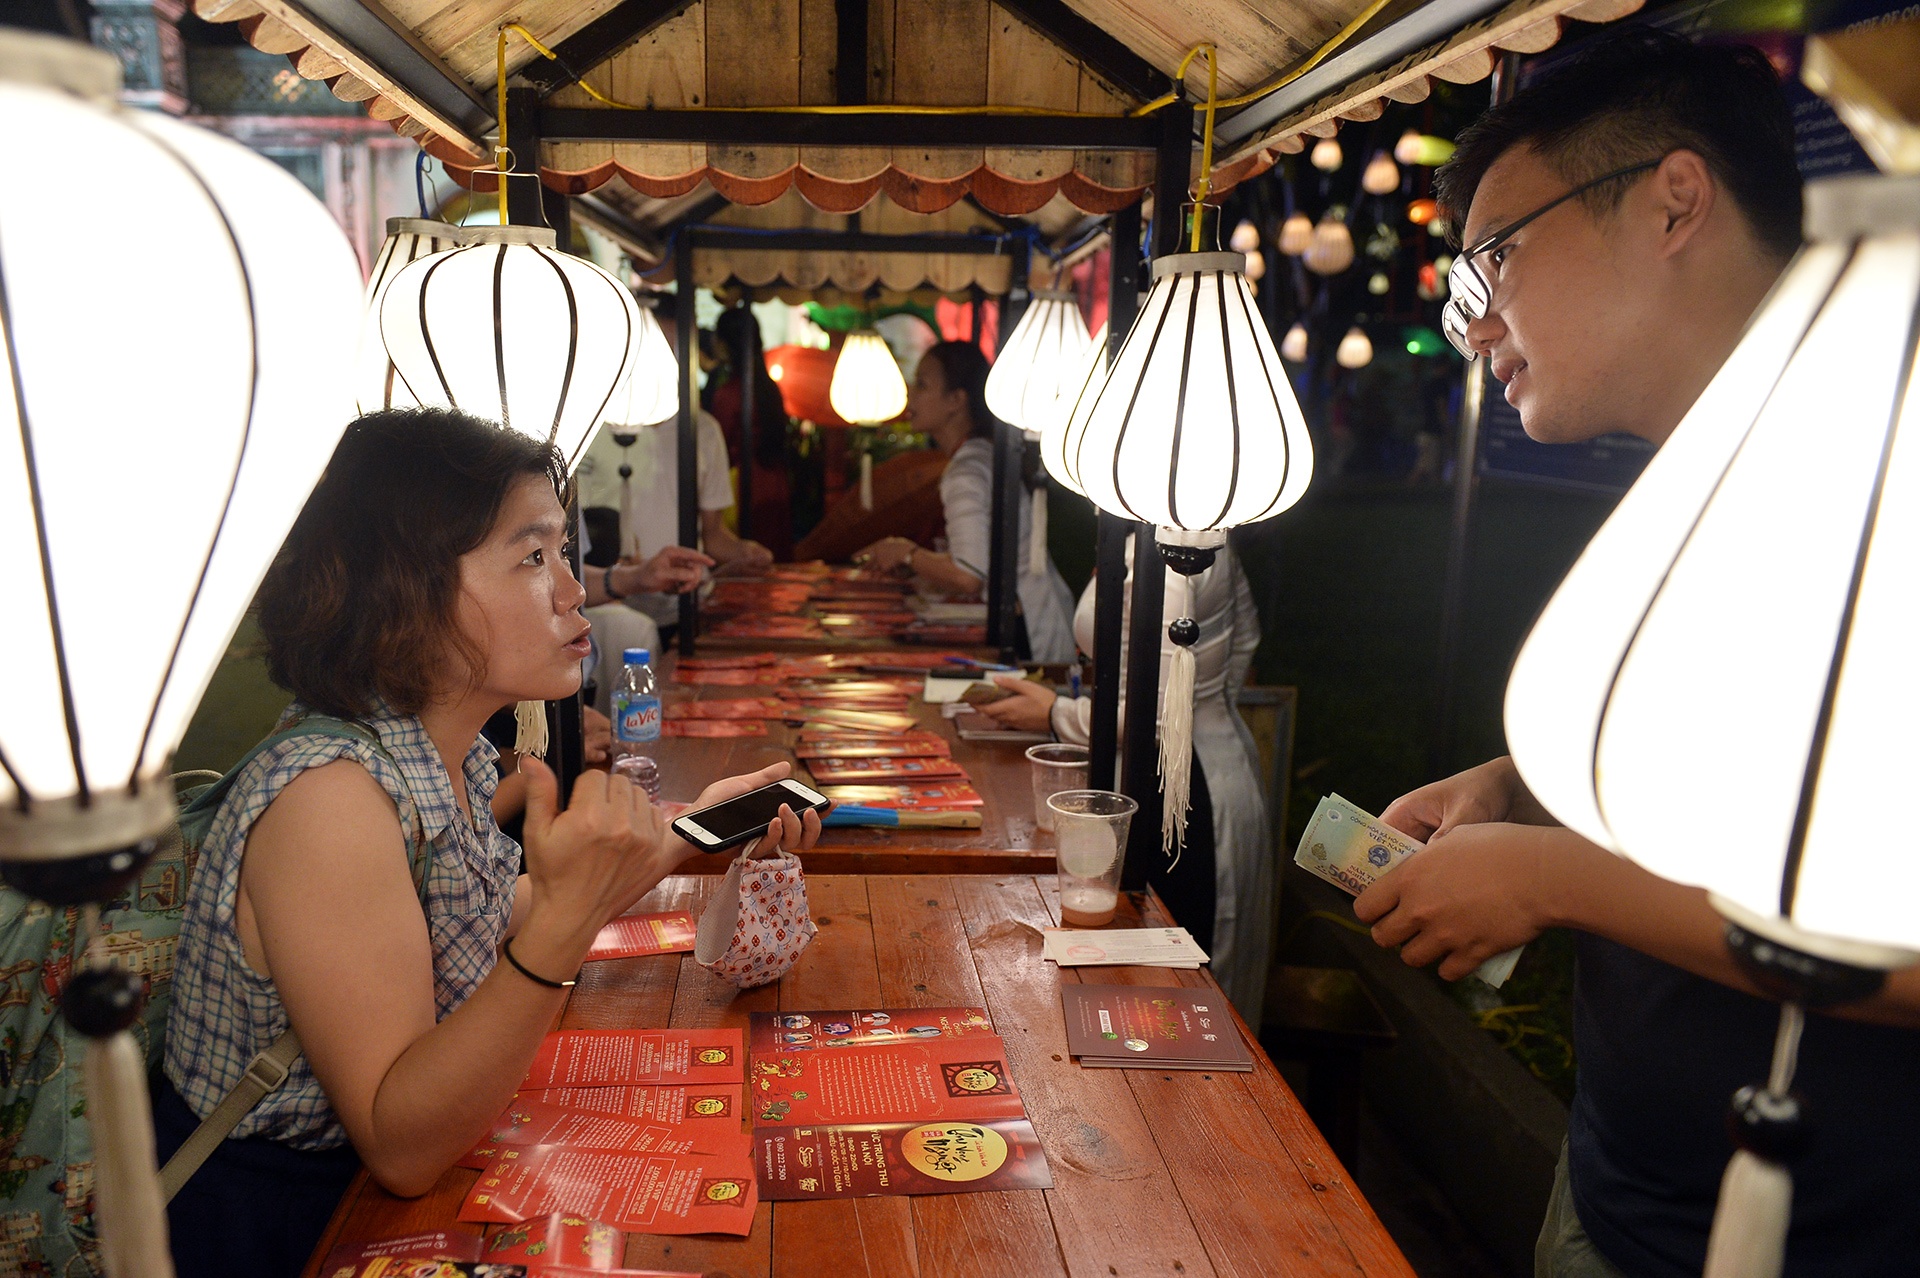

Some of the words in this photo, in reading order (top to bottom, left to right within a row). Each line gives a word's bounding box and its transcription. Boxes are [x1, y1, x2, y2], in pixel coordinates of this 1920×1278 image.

[1369, 832, 1387, 844] VIỆT
[1387, 843, 1405, 855] NAM
[1328, 864, 1368, 893] 5000
[776, 1142, 784, 1153] 090
[861, 1140, 871, 1152] HÀ
[777, 1153, 785, 1164] 222
[862, 1152, 874, 1166] NỘI
[873, 1143, 886, 1169] TRUNG
[778, 1164, 786, 1181] 7500
[878, 1168, 889, 1187] THU
[834, 1175, 843, 1192] GIÁM
